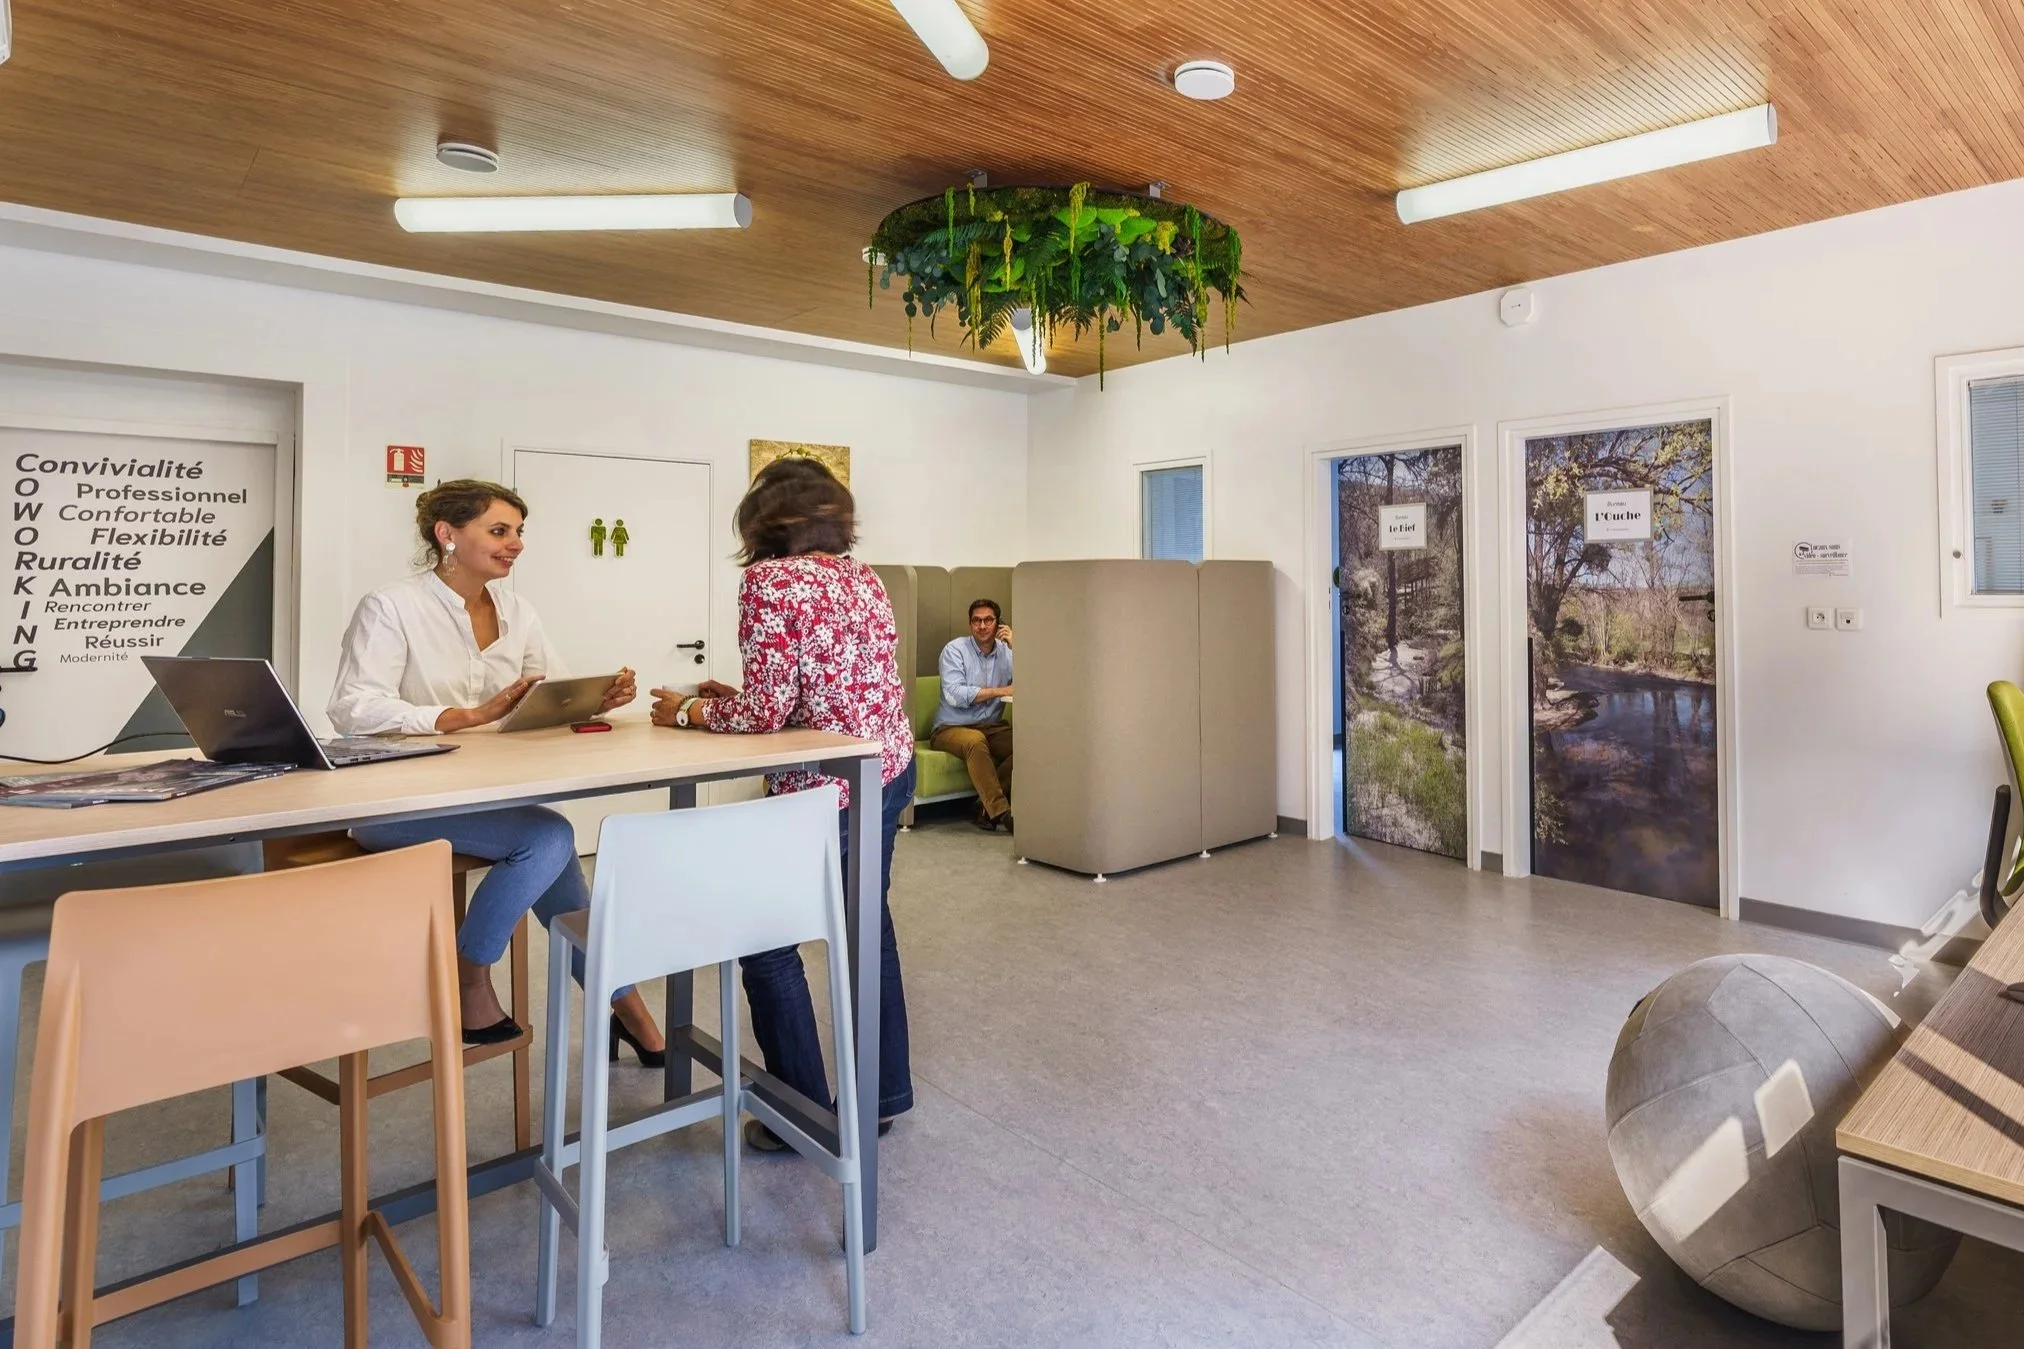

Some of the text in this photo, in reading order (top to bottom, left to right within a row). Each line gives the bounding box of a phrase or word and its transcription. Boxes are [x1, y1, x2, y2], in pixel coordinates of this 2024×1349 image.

[15, 453, 203, 479] Convivialité
[77, 483, 247, 504] Professionnel
[58, 504, 216, 524] Confortable
[1595, 511, 1641, 522] L'Ouche
[90, 528, 228, 547] Flexibilité
[14, 551, 142, 571] Ruralité
[49, 578, 207, 597] Ambiance
[45, 601, 152, 613] Rencontrer
[54, 616, 186, 633] Entreprendre
[85, 634, 165, 650] Réussir
[60, 652, 129, 664] Modernité
